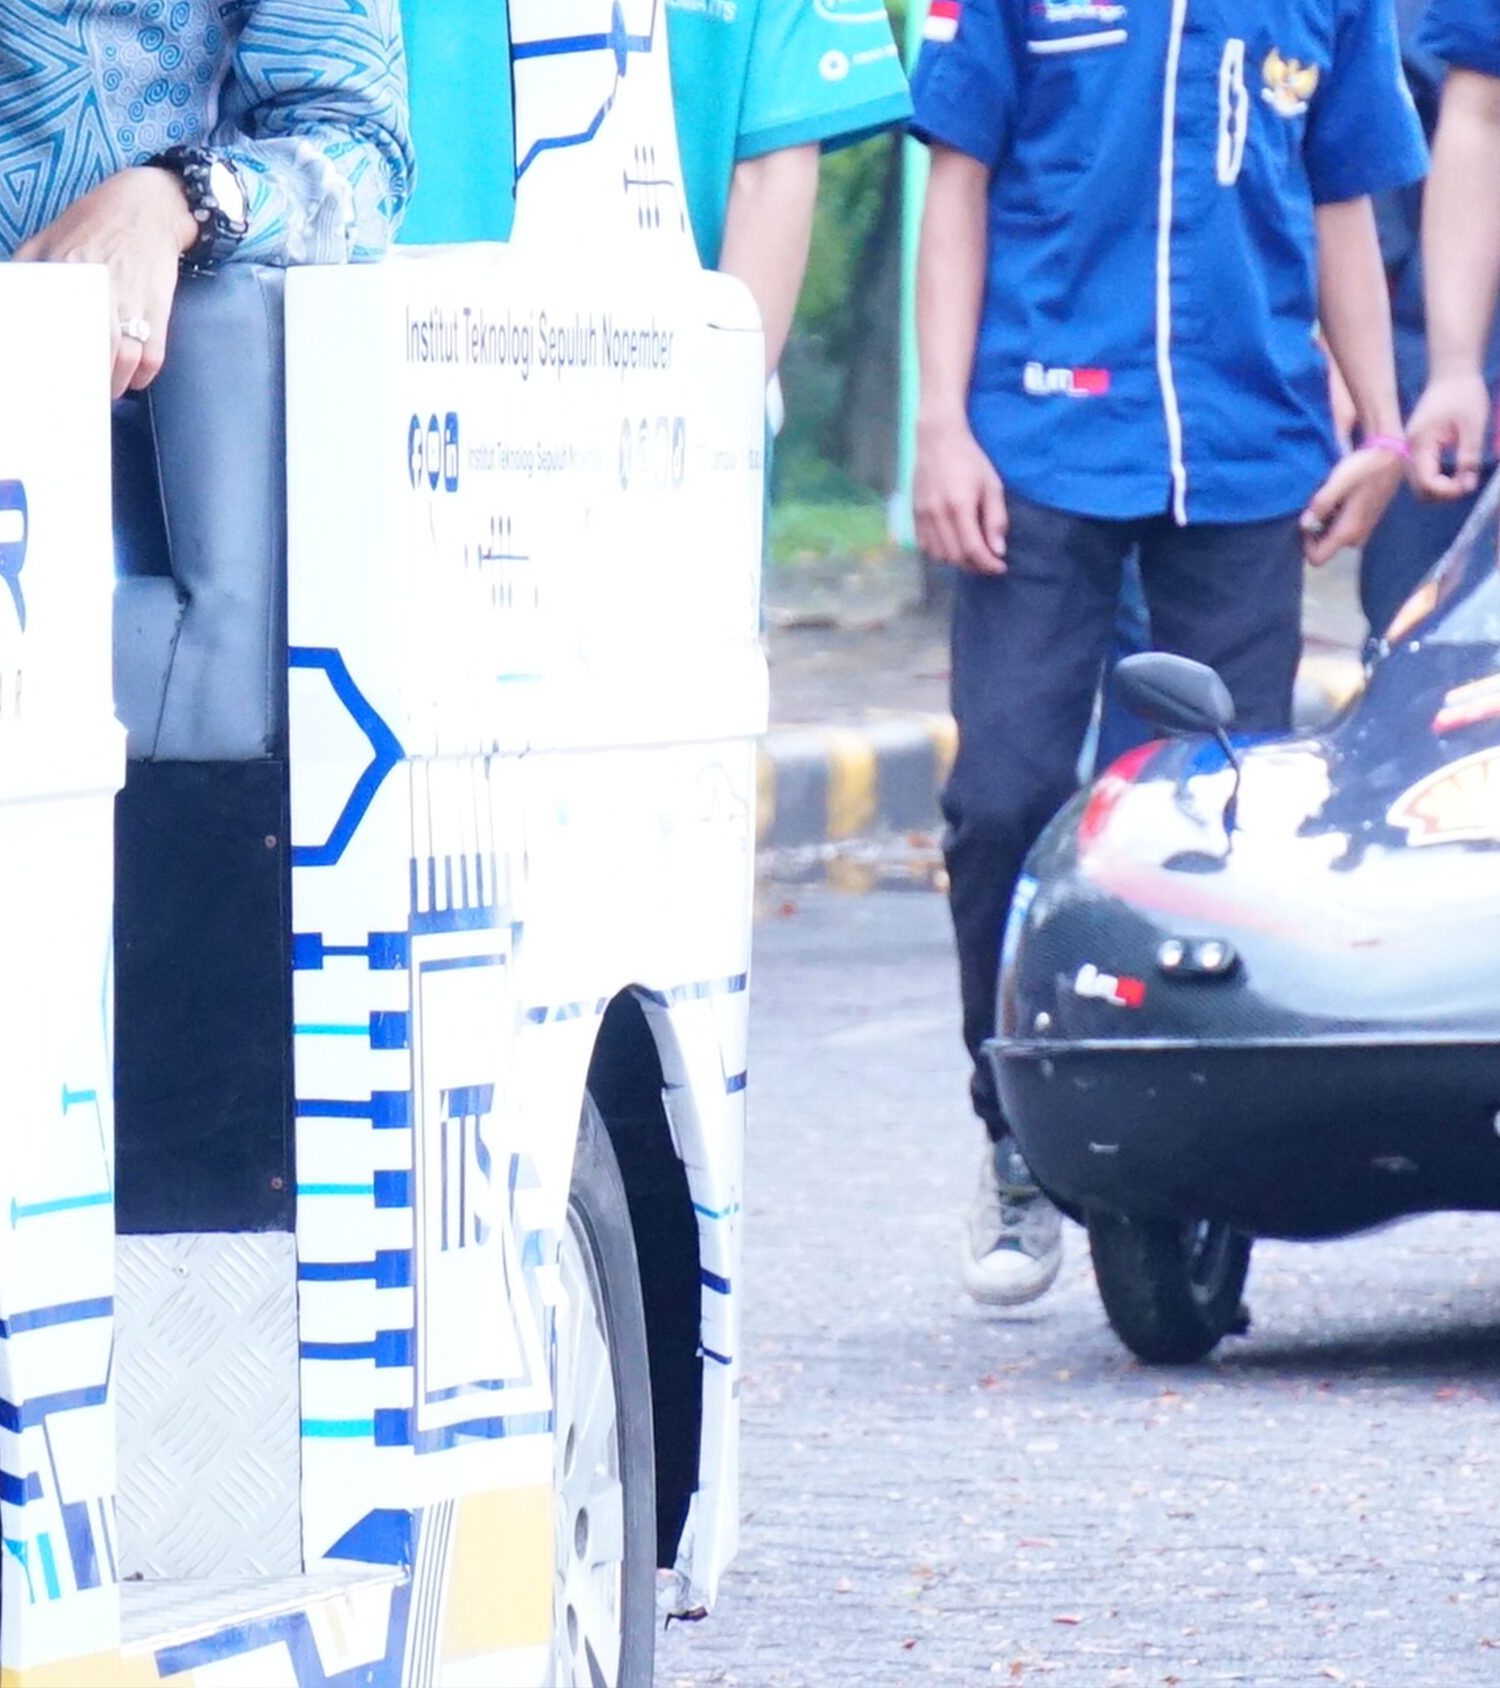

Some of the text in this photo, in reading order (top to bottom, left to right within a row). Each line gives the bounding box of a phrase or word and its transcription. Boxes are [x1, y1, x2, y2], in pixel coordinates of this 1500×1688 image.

[406, 306, 674, 382] Institut Teknologi Sepuluh Nopember
